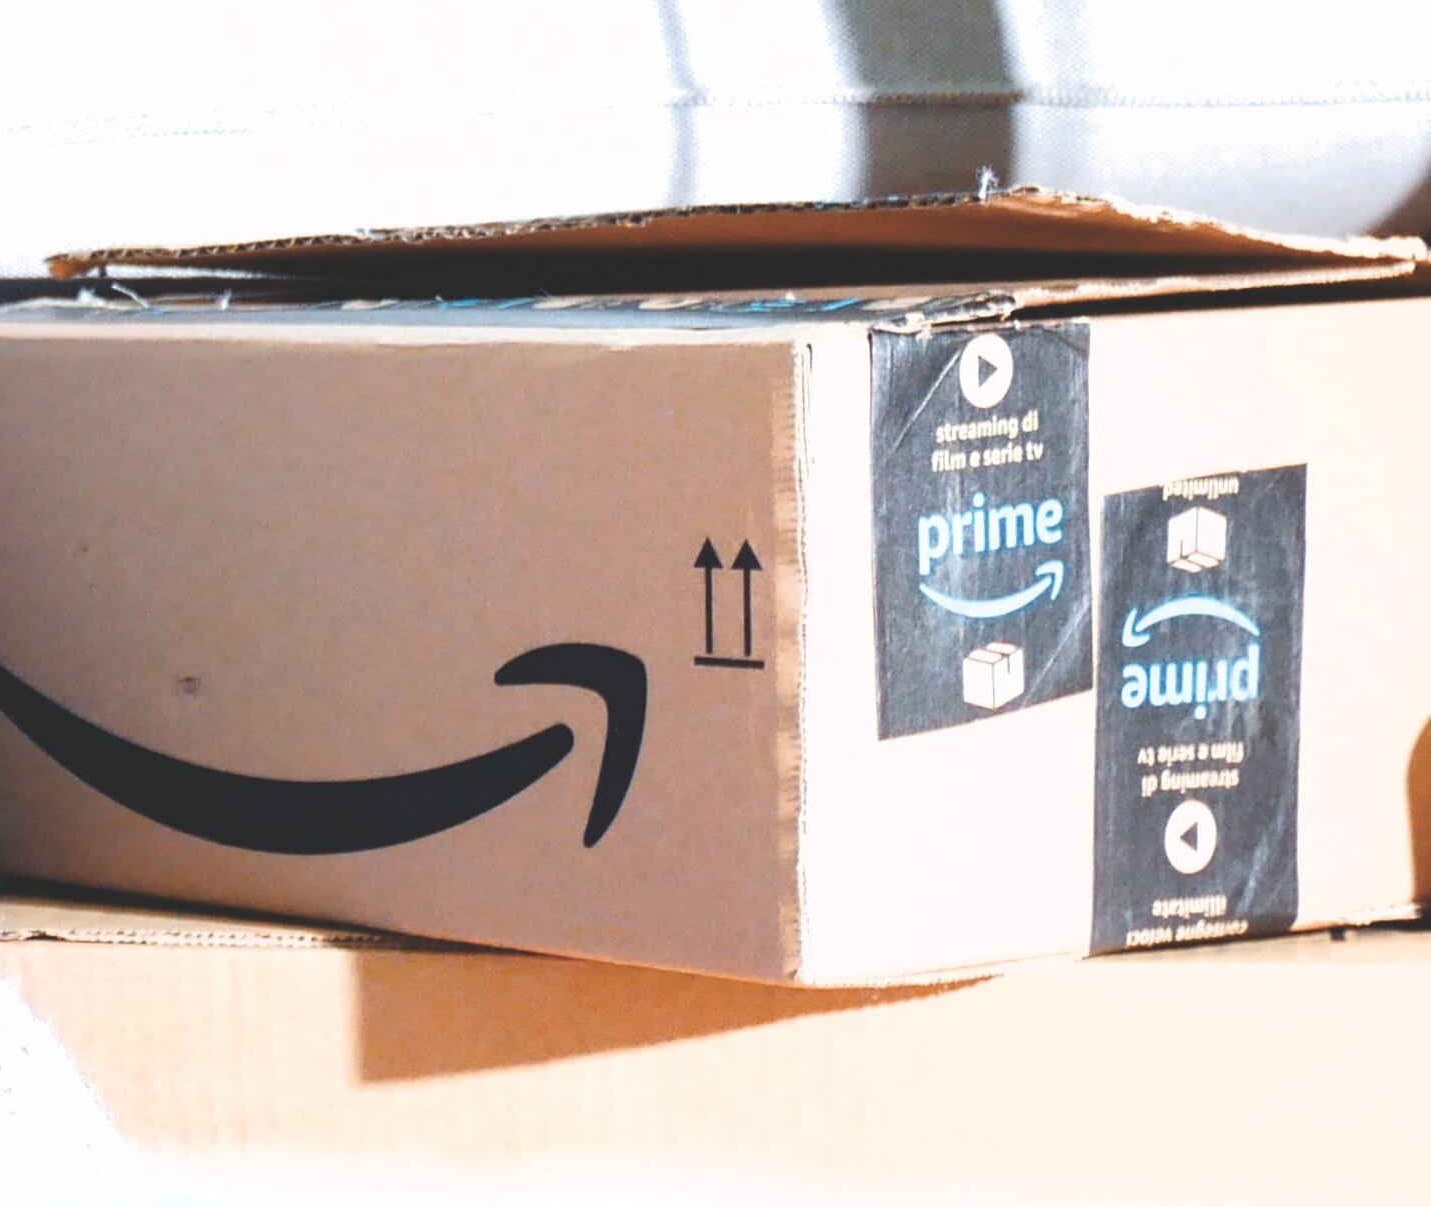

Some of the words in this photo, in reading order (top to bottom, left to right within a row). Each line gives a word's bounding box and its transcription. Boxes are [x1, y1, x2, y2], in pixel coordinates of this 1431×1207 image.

[935, 414, 1018, 444] streaming
[1021, 409, 1039, 433] di
[930, 442, 966, 472] film
[969, 448, 980, 468] e
[982, 440, 1023, 467] serie
[1025, 440, 1044, 461] tv
[918, 492, 1063, 575] prime
[1121, 644, 1261, 720] prime
[1136, 746, 1155, 766] tv
[1157, 745, 1195, 765] serie
[1197, 744, 1209, 762] e
[1212, 741, 1244, 764] film
[1140, 774, 1158, 797] di
[1160, 768, 1239, 794] streaming
[1151, 894, 1227, 918] illimitate
